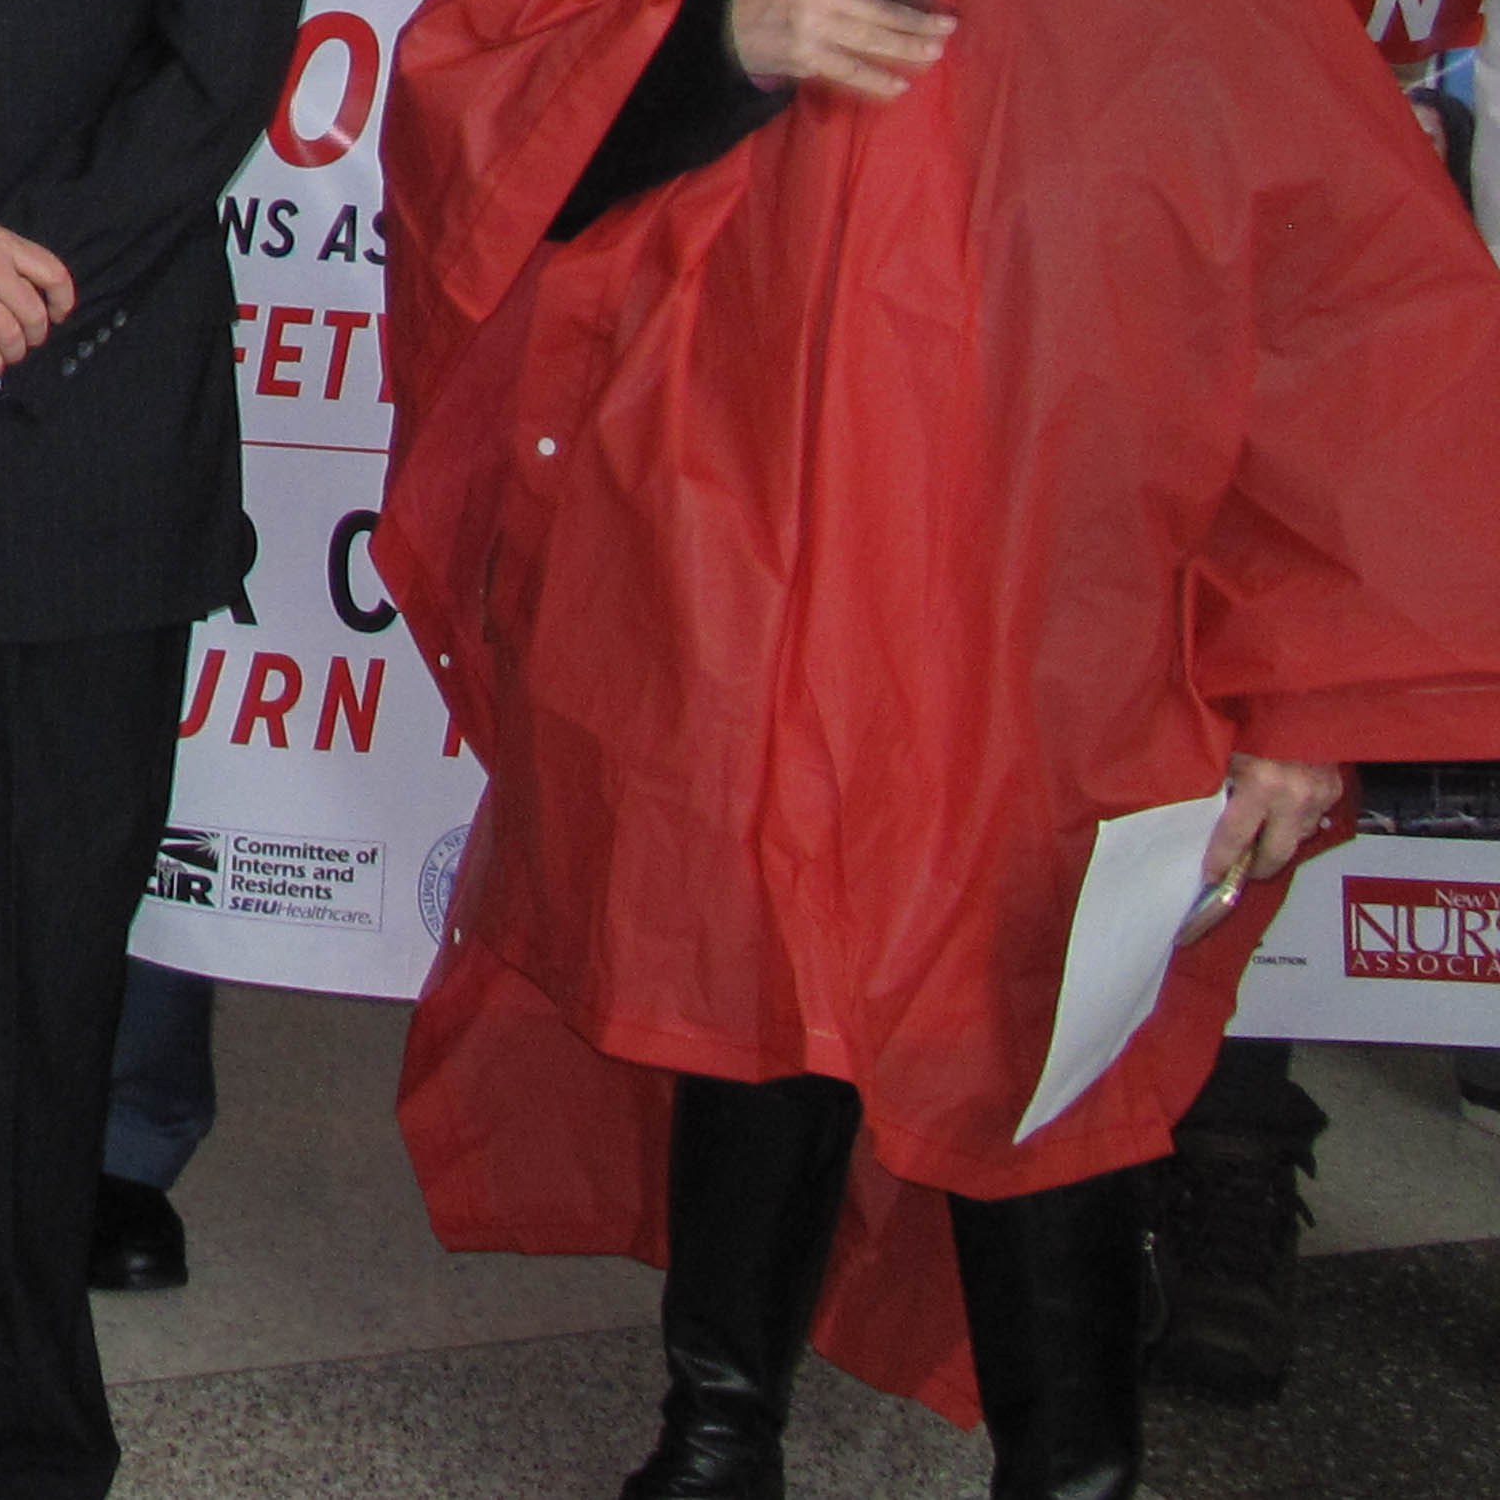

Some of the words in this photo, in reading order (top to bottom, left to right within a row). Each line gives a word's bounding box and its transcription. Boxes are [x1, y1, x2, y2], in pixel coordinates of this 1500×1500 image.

[233, 836, 350, 864] Committee
[355, 847, 379, 866] of
[231, 856, 306, 879] Interns
[313, 864, 355, 883] and
[230, 876, 333, 901] Residents
[1435, 888, 1486, 908] New
